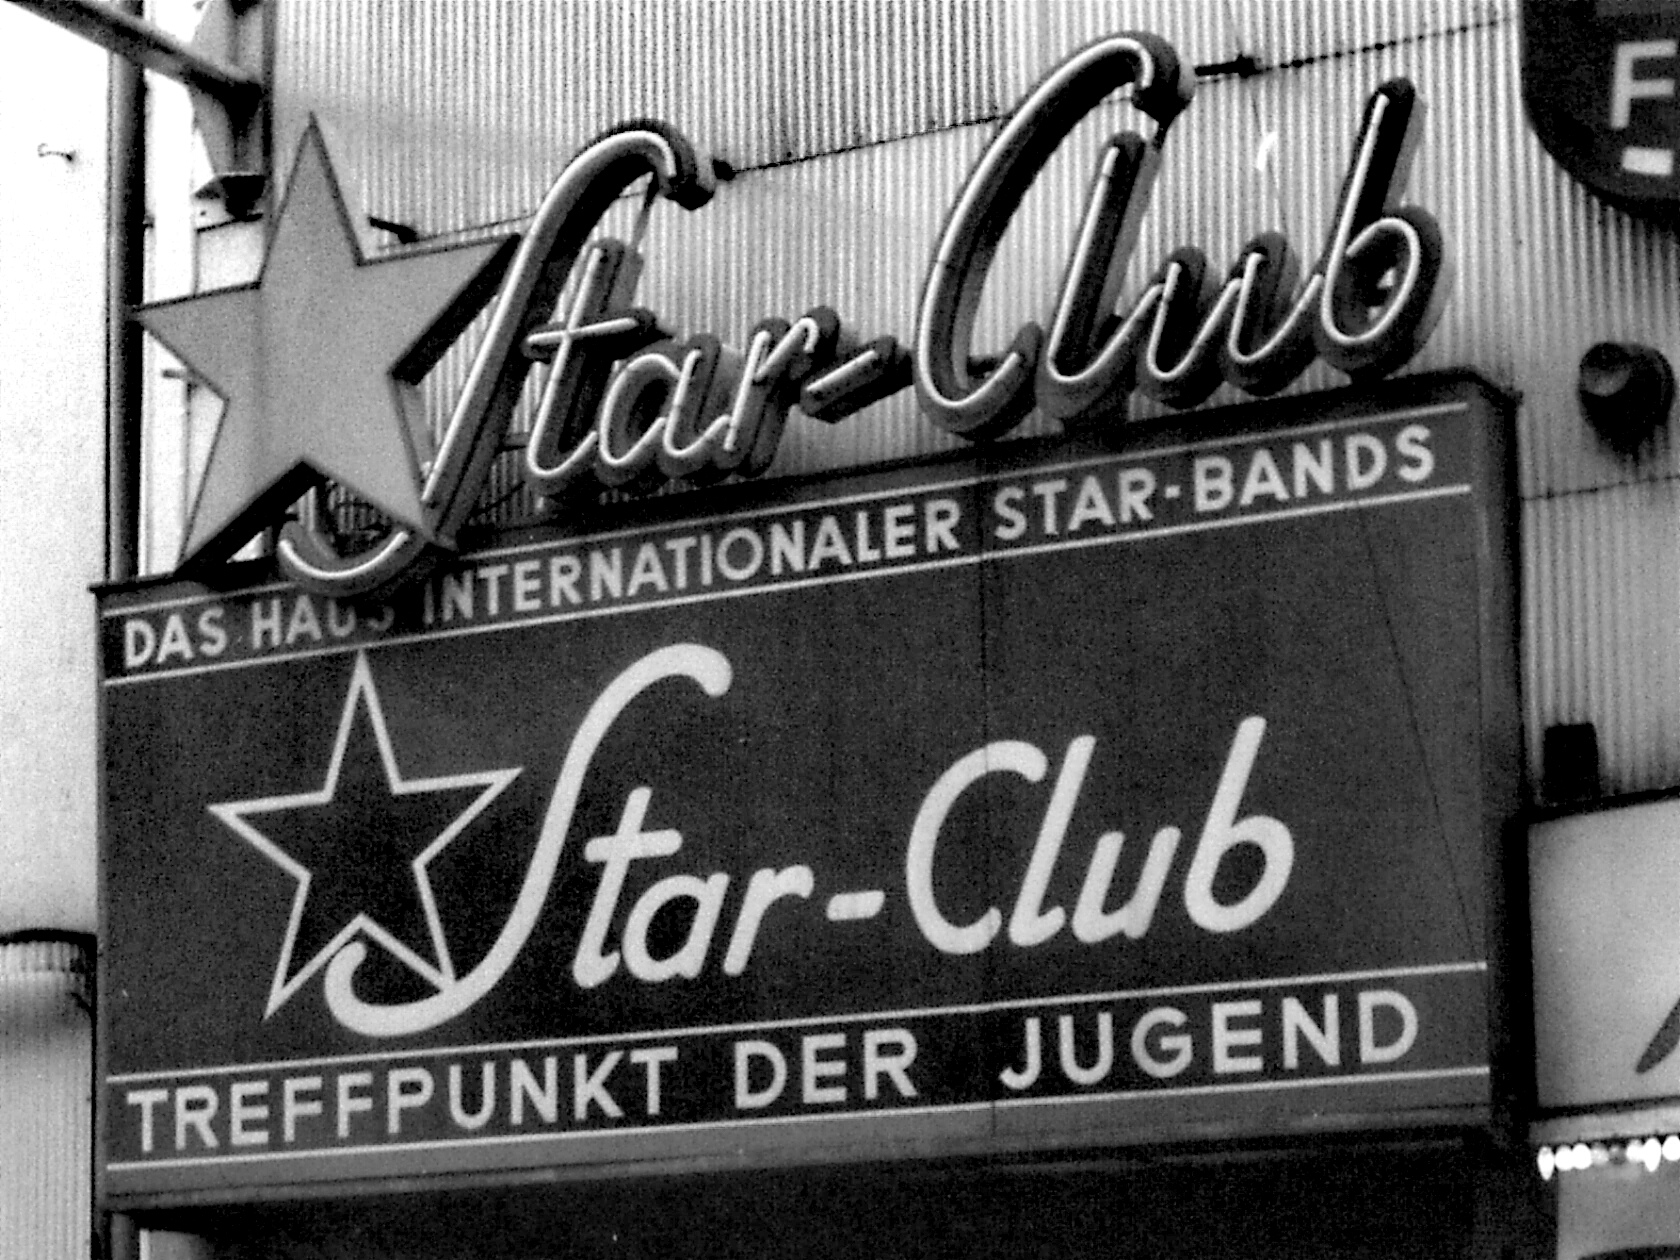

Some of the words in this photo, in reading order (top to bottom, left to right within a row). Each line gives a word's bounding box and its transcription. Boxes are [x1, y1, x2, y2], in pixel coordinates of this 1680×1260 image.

[278, 30, 1455, 597] Star-Club
[124, 606, 228, 668] DAS
[423, 500, 961, 625] INTERNATIONALER
[992, 425, 1435, 541] STAR-BANDS
[324, 643, 1294, 1036] Star-Club
[126, 1046, 679, 1153] TREFFPUNKT
[732, 1029, 918, 1110] DER
[1000, 989, 1418, 1090] JUGEND
